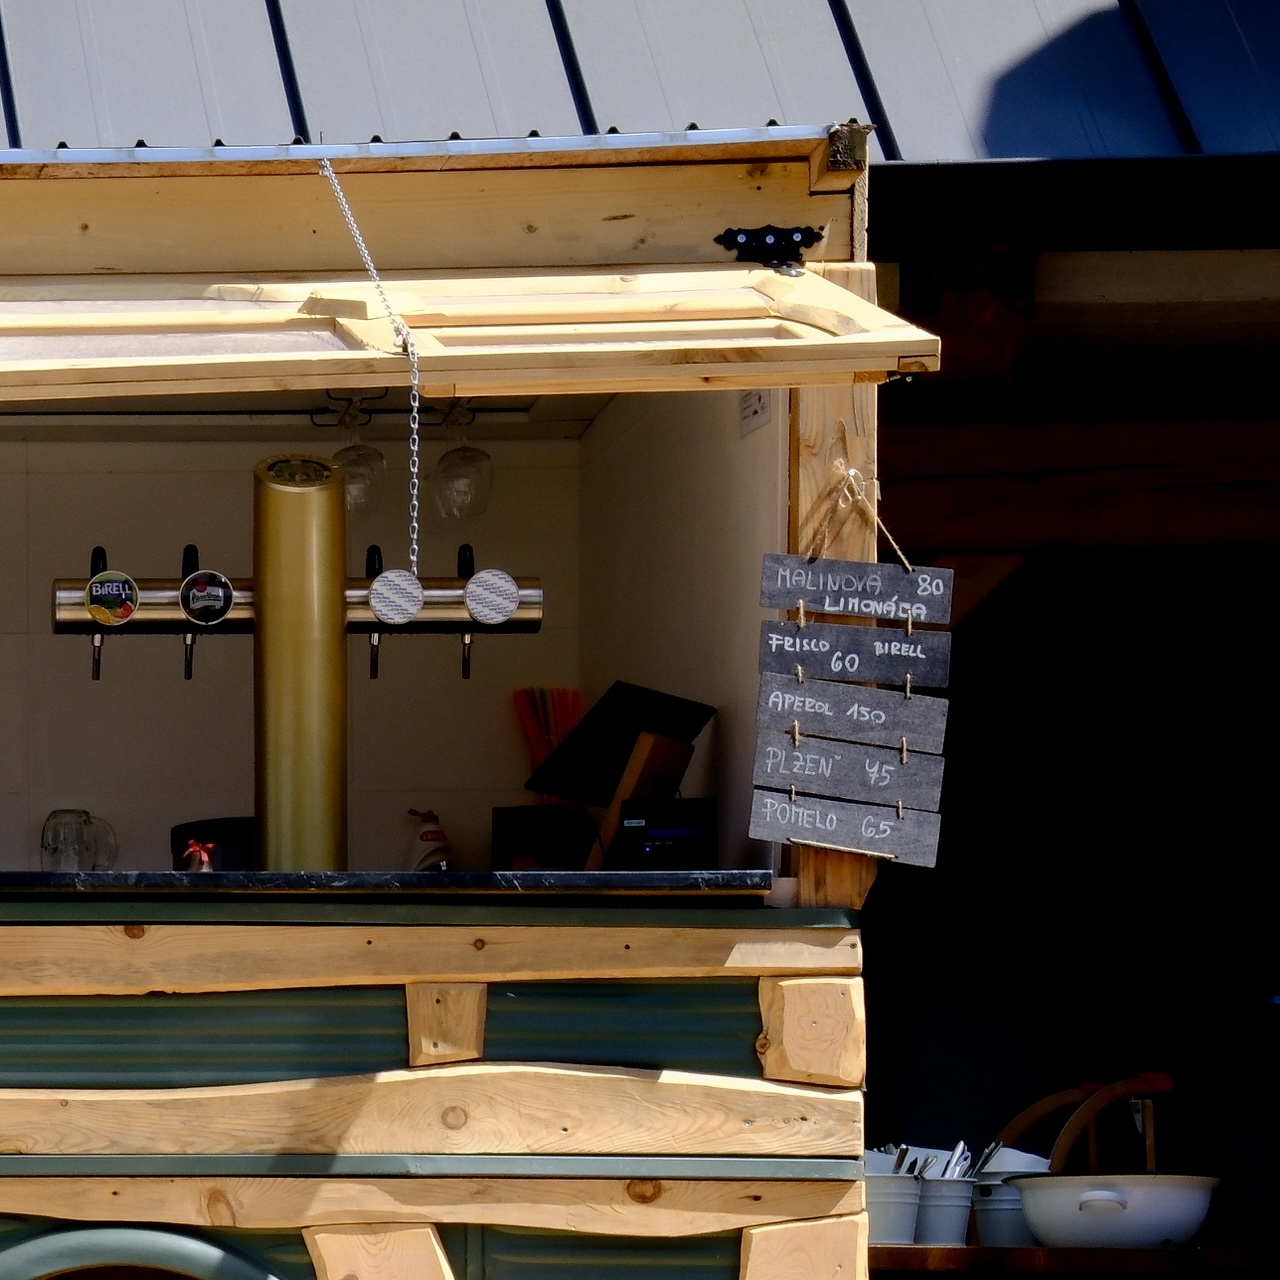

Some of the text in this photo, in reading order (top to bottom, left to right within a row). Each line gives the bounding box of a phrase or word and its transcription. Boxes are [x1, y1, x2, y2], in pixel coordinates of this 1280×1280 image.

[917, 574, 944, 595] 80
[768, 634, 926, 659] FRISCO BIRELL
[830, 653, 860, 673] 60
[768, 691, 886, 724] APEROL 150
[865, 759, 896, 786] 45
[761, 798, 895, 838] POMELO 65
